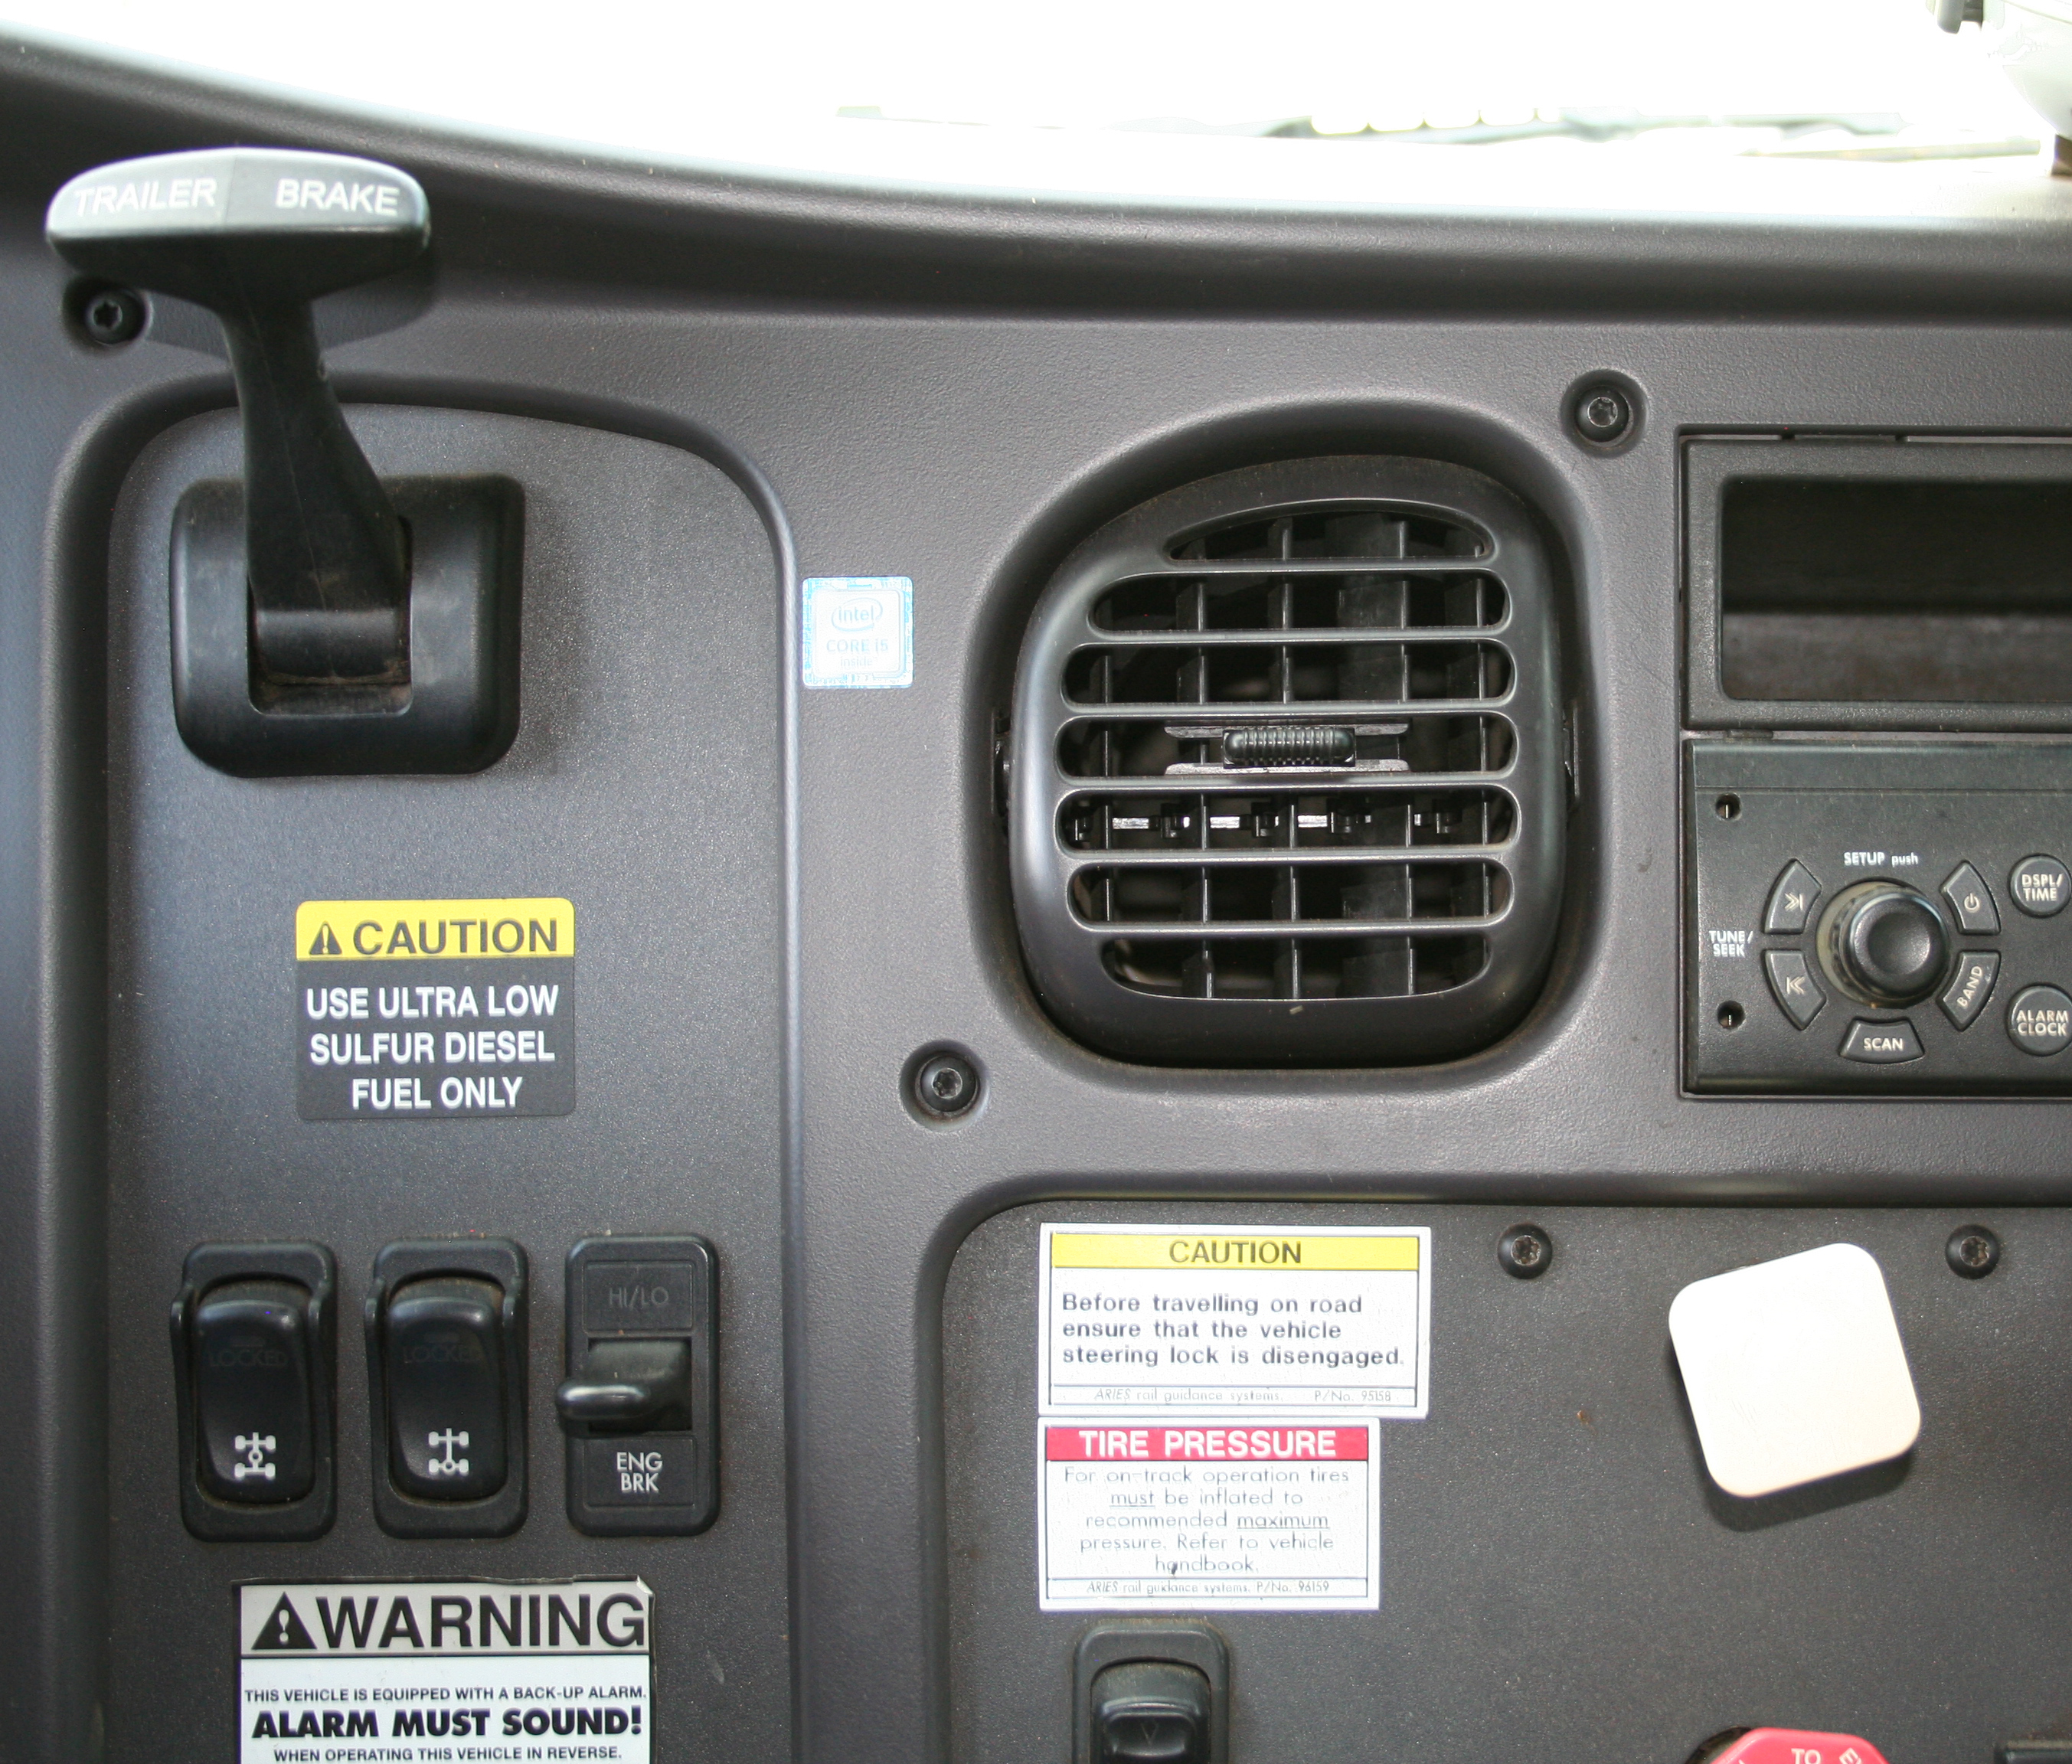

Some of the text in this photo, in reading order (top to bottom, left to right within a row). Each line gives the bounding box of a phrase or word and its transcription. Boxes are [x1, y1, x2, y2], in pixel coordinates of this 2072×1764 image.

[75, 178, 400, 217] TRAILER BRAKE
[838, 605, 874, 623] intel
[825, 639, 871, 654] CORE
[1843, 851, 1919, 867] SETUP push
[2021, 873, 2064, 887] DSPL/
[2023, 887, 2057, 901] TIME
[353, 918, 557, 955] CAUTION
[1708, 929, 1754, 944] TUNE/
[1712, 942, 1747, 957] SEEK
[1956, 965, 1983, 1008] BAND
[306, 985, 559, 1020] USE ULTRA LOW
[2016, 1009, 2069, 1024] ALARM
[2016, 1022, 2068, 1037] CLOCK
[309, 1030, 556, 1065] SULFUR DIESEL
[1863, 1037, 1904, 1052] SCAN
[351, 1076, 523, 1109] FUEL ONLY
[1168, 1239, 1302, 1264] CAUTION
[1062, 1292, 1362, 1316] Before travelling on road
[1062, 1320, 1342, 1339] ensure that the vehicle
[1062, 1345, 1405, 1368] steering lock is disengaged.
[1093, 1389, 1131, 1402] ARIES
[1136, 1389, 1158, 1402] rail
[1164, 1390, 1223, 1404] guidance
[1079, 1430, 1337, 1457] TIRE PRESSURE
[616, 1451, 662, 1473] ENG
[620, 1472, 659, 1494] BRK
[1064, 1465, 1349, 1488] For on-track operation tires
[1110, 1488, 1303, 1507] must be inflated to
[1086, 1511, 1329, 1529] recommended maximum
[1080, 1533, 1335, 1554] pressure. Refer to vehicle
[1087, 1581, 1118, 1593] ARIES
[1123, 1581, 1142, 1593] rail
[1147, 1581, 1198, 1595] guidance
[315, 1592, 645, 1648] WARNING
[244, 1685, 647, 1703] THIS VEHICLE IS EQUIPPED WITH A BACK-UP ALARM.
[251, 1705, 642, 1739] ALARM MUST SOUND!
[273, 1746, 623, 1762] WHEN OPERATING THIS VEHICLE IN REVERSE.
